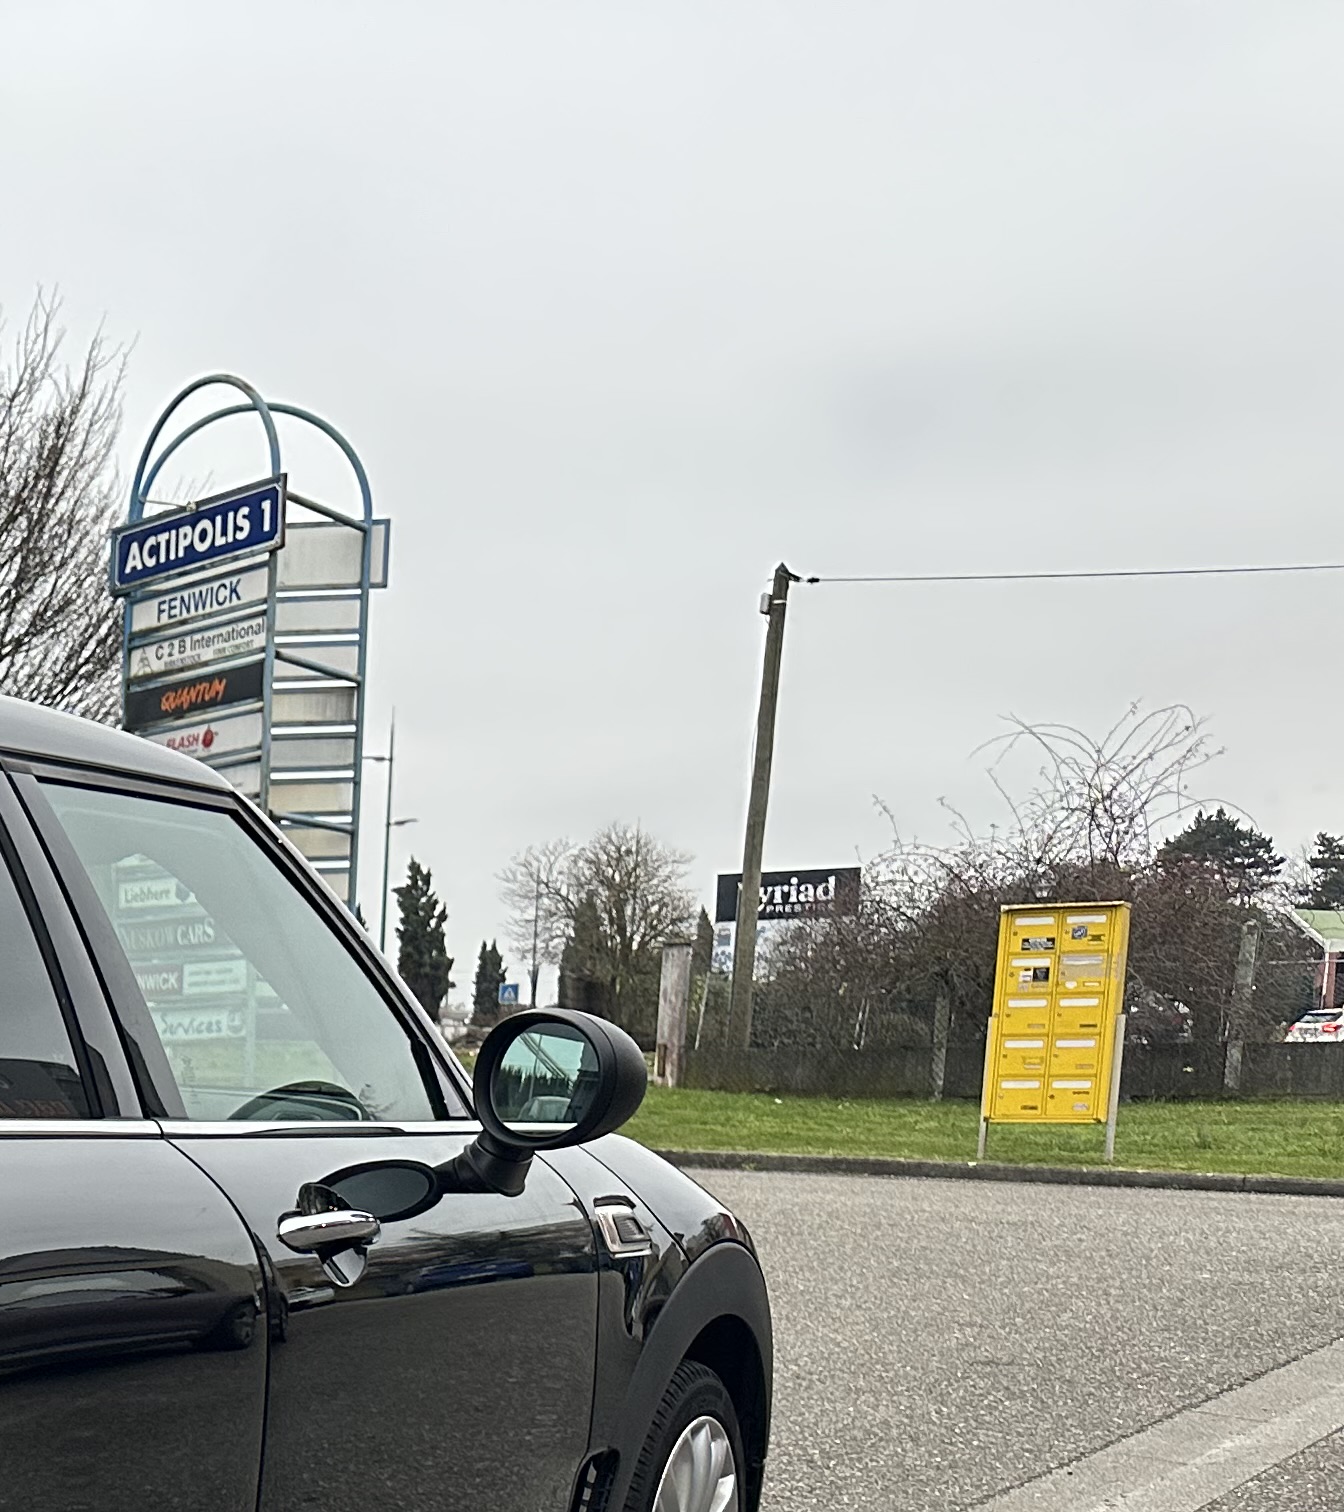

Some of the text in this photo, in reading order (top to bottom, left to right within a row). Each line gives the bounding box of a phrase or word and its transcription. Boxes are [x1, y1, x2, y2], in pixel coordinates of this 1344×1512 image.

[124, 499, 272, 575] ACTIPOLIS 1
[157, 578, 242, 623] FENWICK
[155, 621, 265, 661] C 2 B International
[160, 678, 227, 713] QUANTUM
[738, 876, 836, 912] yriad
[177, 918, 215, 946] CARS
